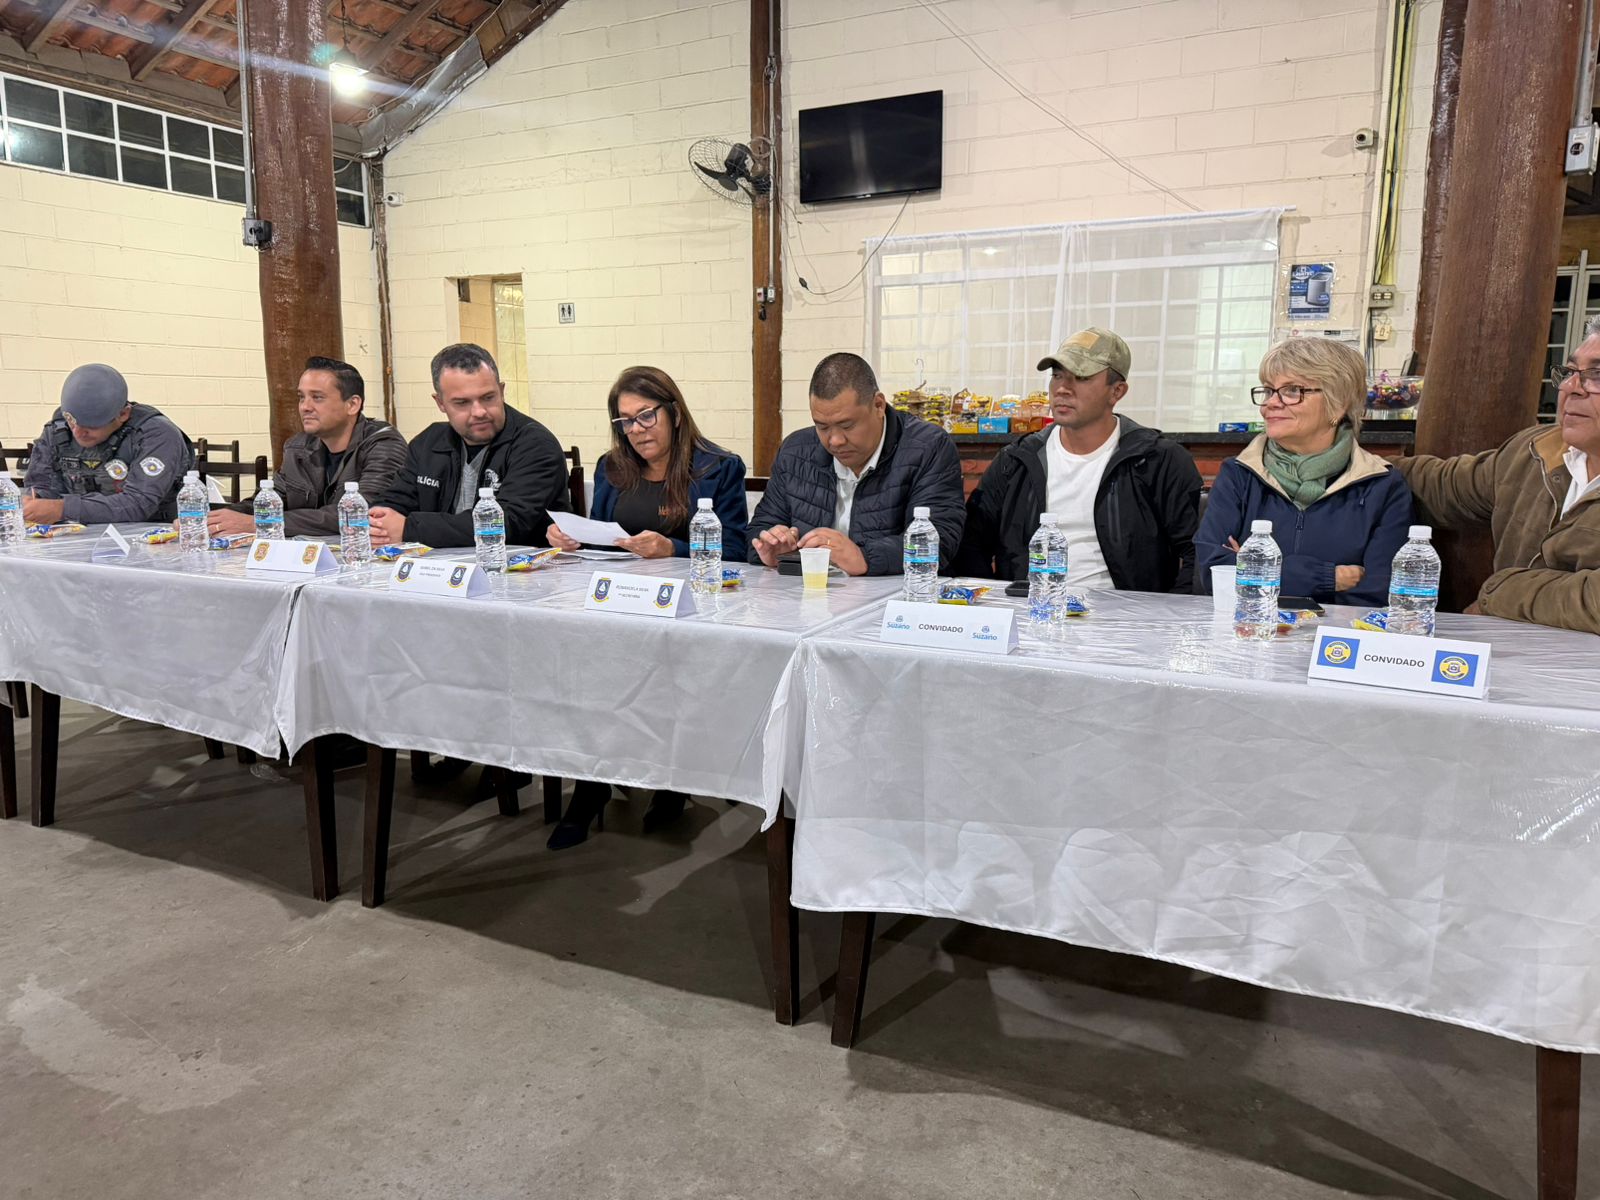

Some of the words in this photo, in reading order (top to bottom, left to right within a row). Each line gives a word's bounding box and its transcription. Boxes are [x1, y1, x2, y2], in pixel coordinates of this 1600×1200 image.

[918, 623, 964, 633] CONVIDADO
[972, 632, 997, 640] Suzano
[1363, 654, 1425, 667] CONVIDADO
